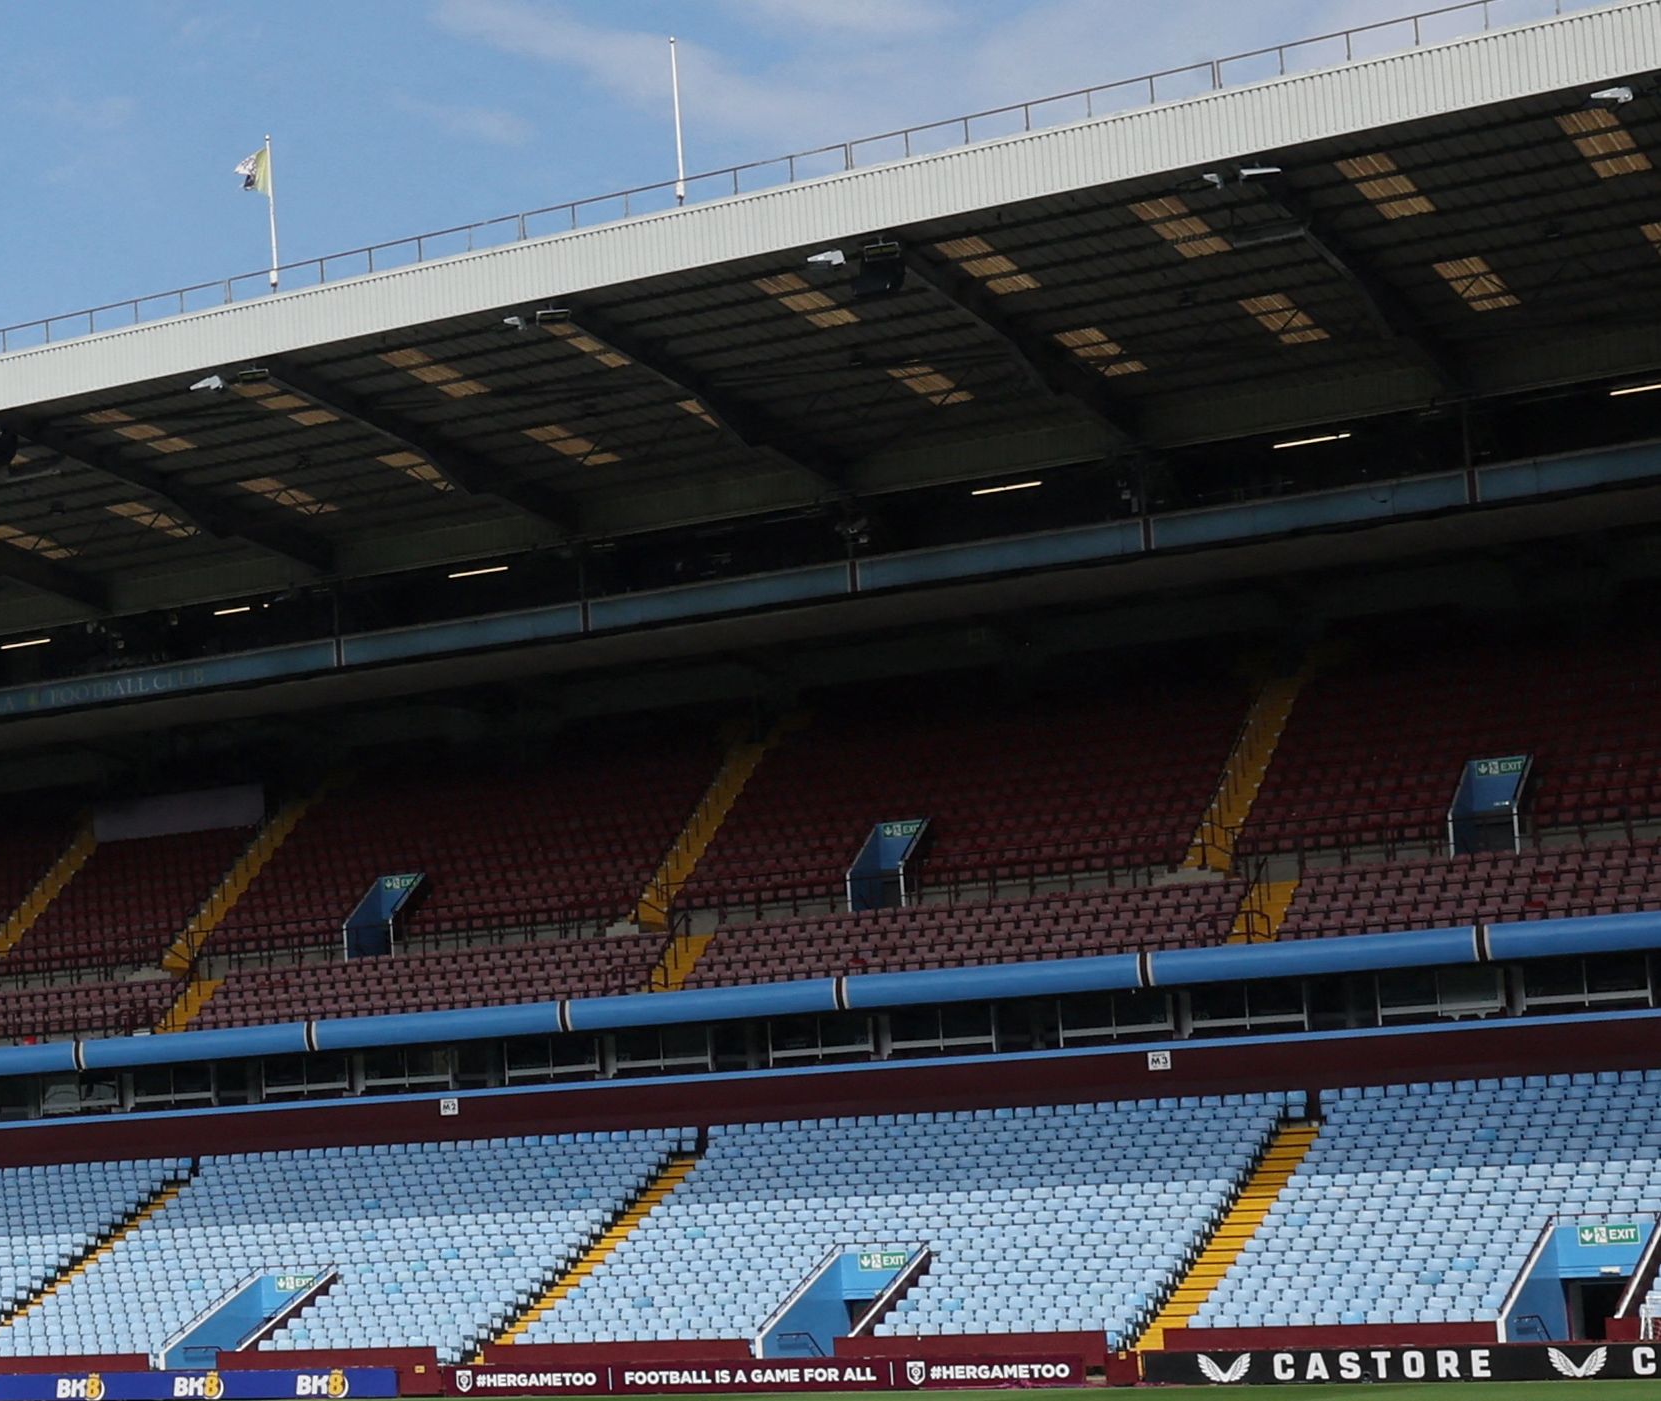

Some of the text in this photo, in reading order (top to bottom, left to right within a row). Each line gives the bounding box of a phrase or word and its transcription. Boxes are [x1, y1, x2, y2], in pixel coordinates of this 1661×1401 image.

[1499, 760, 1523, 771] EXIT
[1608, 1227, 1637, 1240] EXIT
[882, 1255, 905, 1266] EXIT
[1273, 1349, 1492, 1381] CASTORE
[476, 1363, 1070, 1388] #HERGAMETOO FOOTBALL IS A GAME FOR ALL #HERGAMETOO
[56, 1377, 105, 1401] BK8
[173, 1374, 224, 1400] BK8
[296, 1373, 349, 1399] BK8
